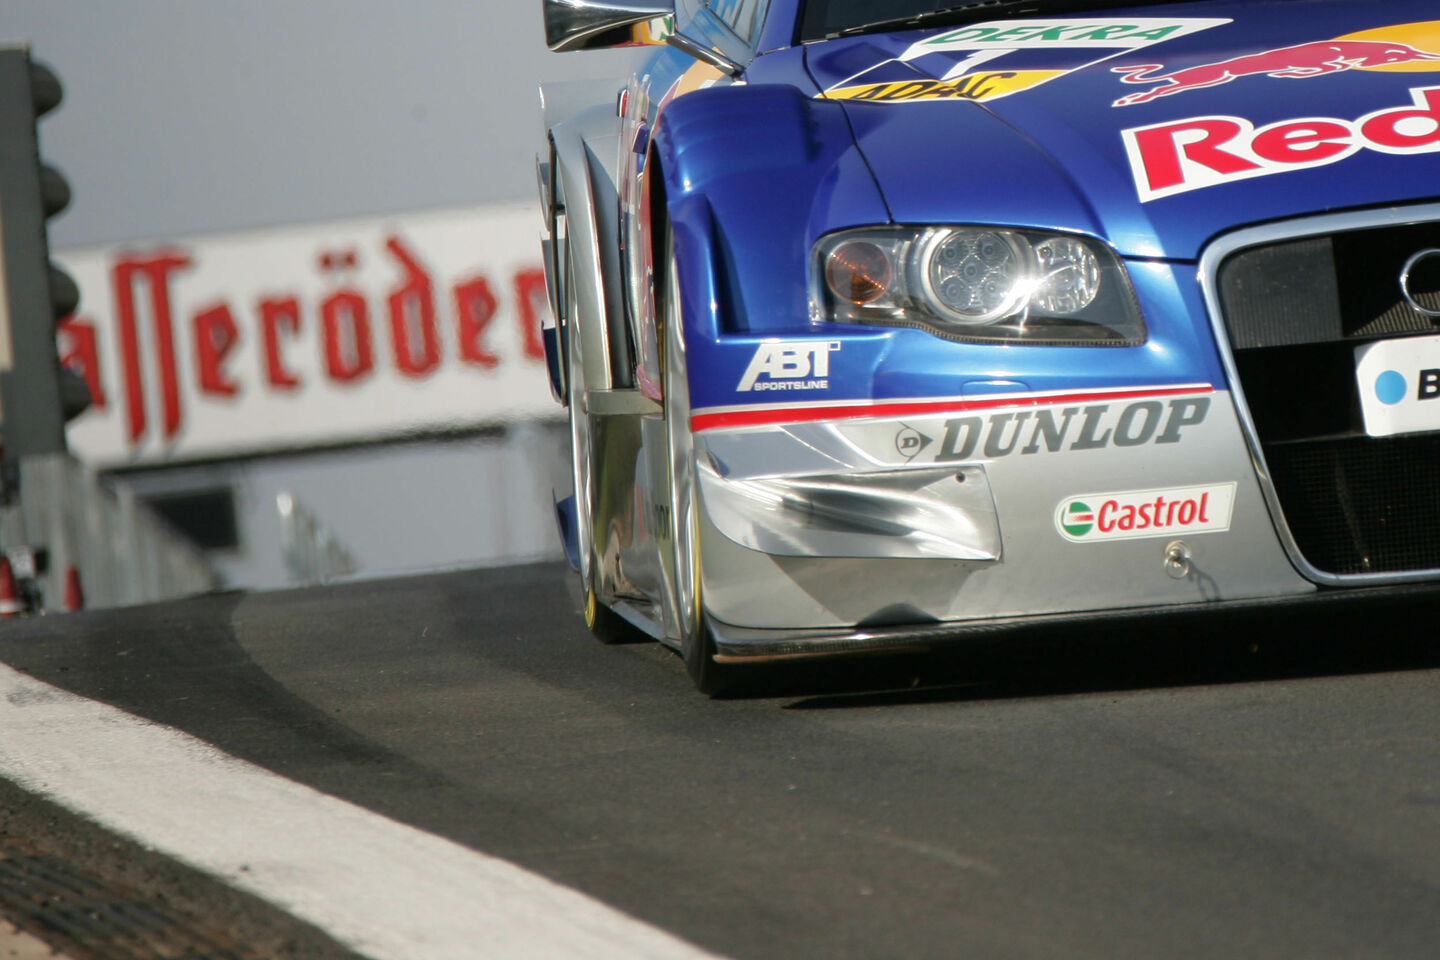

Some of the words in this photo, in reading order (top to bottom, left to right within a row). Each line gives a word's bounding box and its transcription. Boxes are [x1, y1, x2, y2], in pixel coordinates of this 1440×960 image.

[922, 24, 1182, 44] DEKRA
[850, 72, 1016, 101] ADAC
[736, 341, 829, 392] ABT
[753, 379, 829, 392] SPORTSLINE
[933, 396, 1211, 463] DUNLOP
[1097, 492, 1210, 534] Castrol
